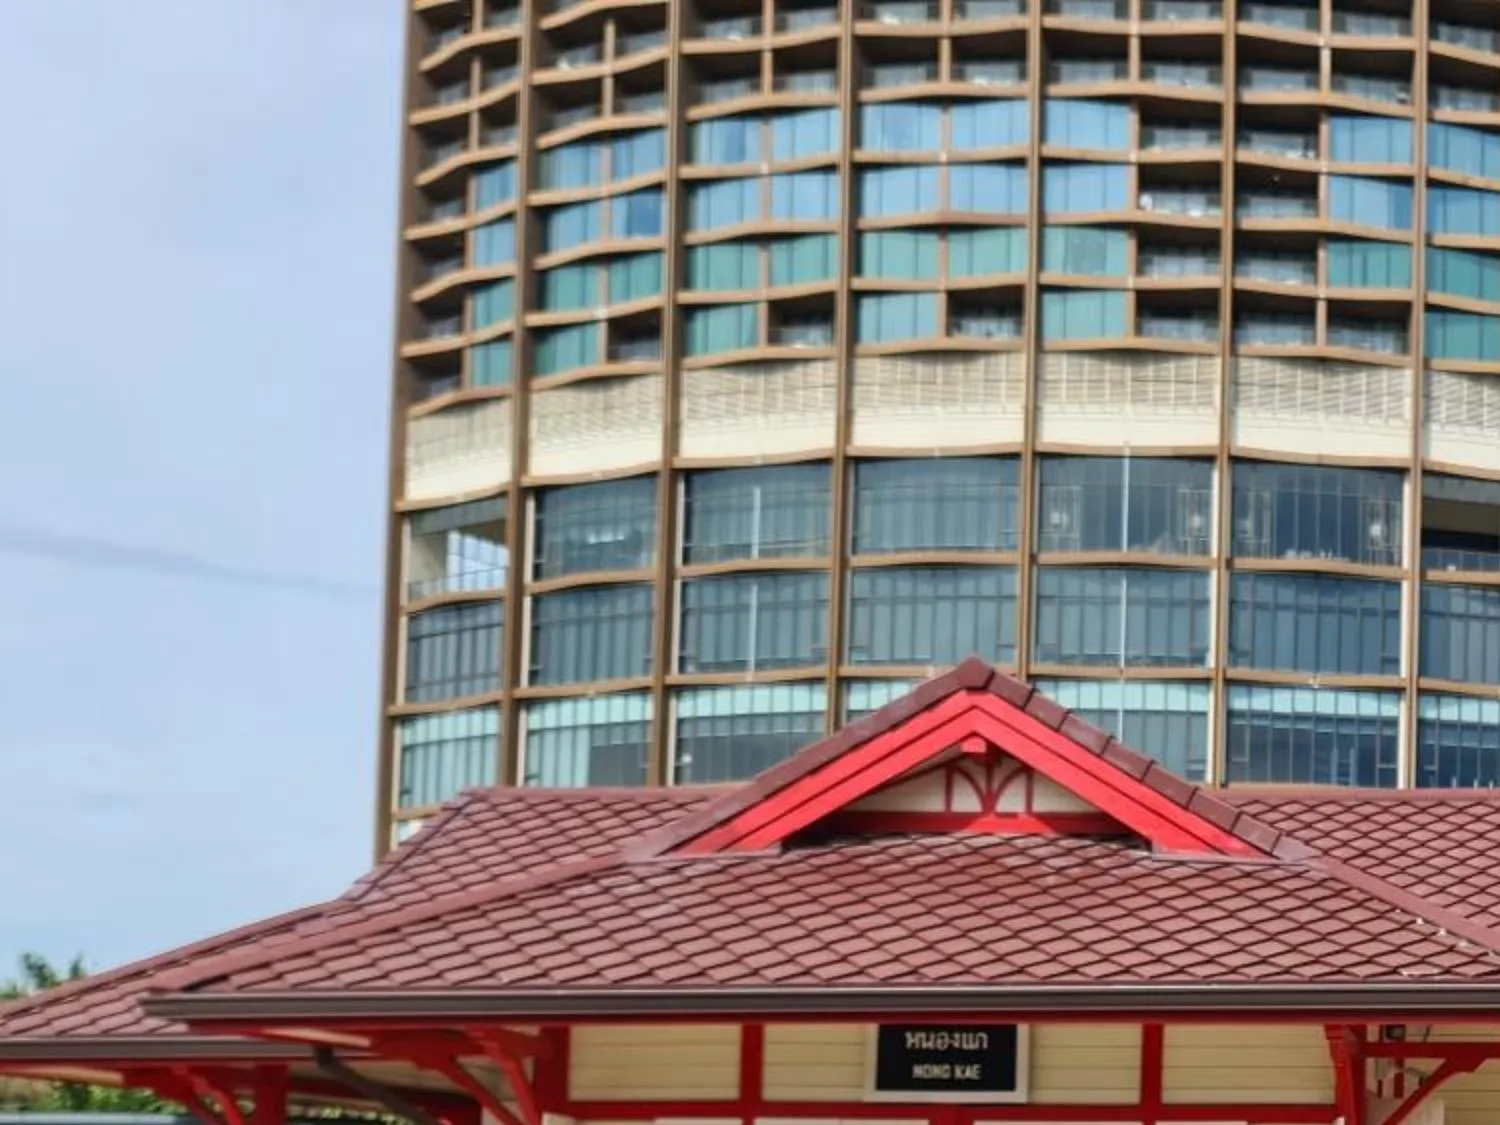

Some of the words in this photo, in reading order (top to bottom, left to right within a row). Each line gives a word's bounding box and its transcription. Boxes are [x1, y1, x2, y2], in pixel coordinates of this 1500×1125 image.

[904, 1030, 989, 1051] หนองแก
[912, 1063, 952, 1080] NONG
[954, 1063, 983, 1080] KAE
